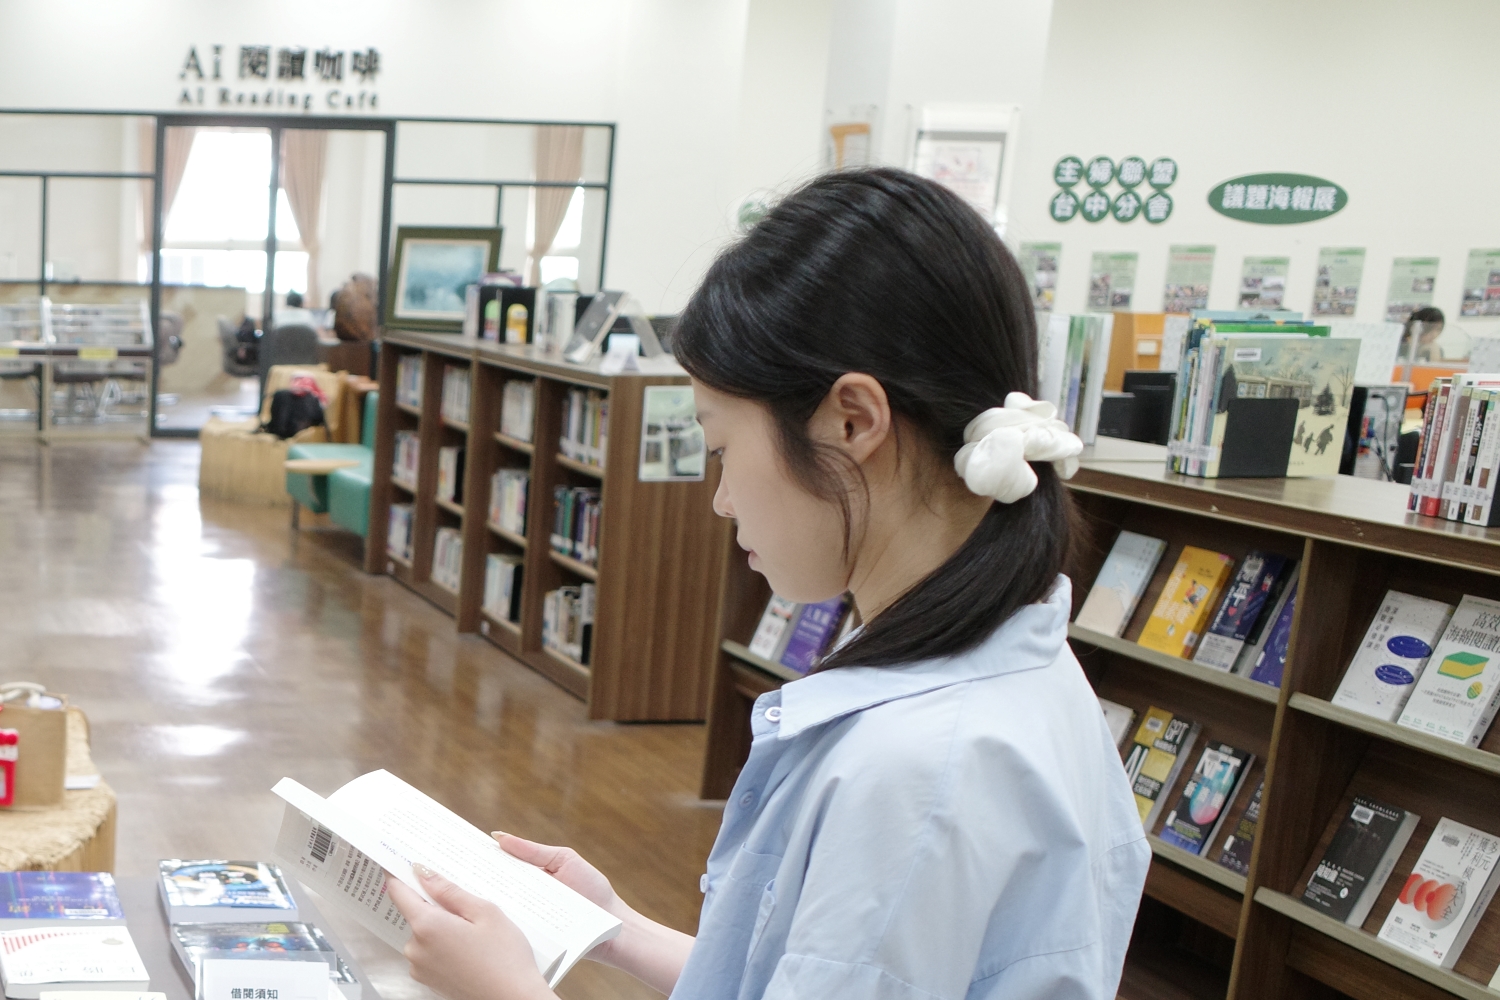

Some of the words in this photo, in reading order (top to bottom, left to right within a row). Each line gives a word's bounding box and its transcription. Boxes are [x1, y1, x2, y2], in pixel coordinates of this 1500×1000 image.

[180, 44, 223, 80] AI
[1056, 159, 1176, 186] 主婦聯盟
[1052, 193, 1171, 221] 台中分會
[1221, 183, 1338, 213] 議題海報展
[231, 987, 279, 1000] 借閱須知
